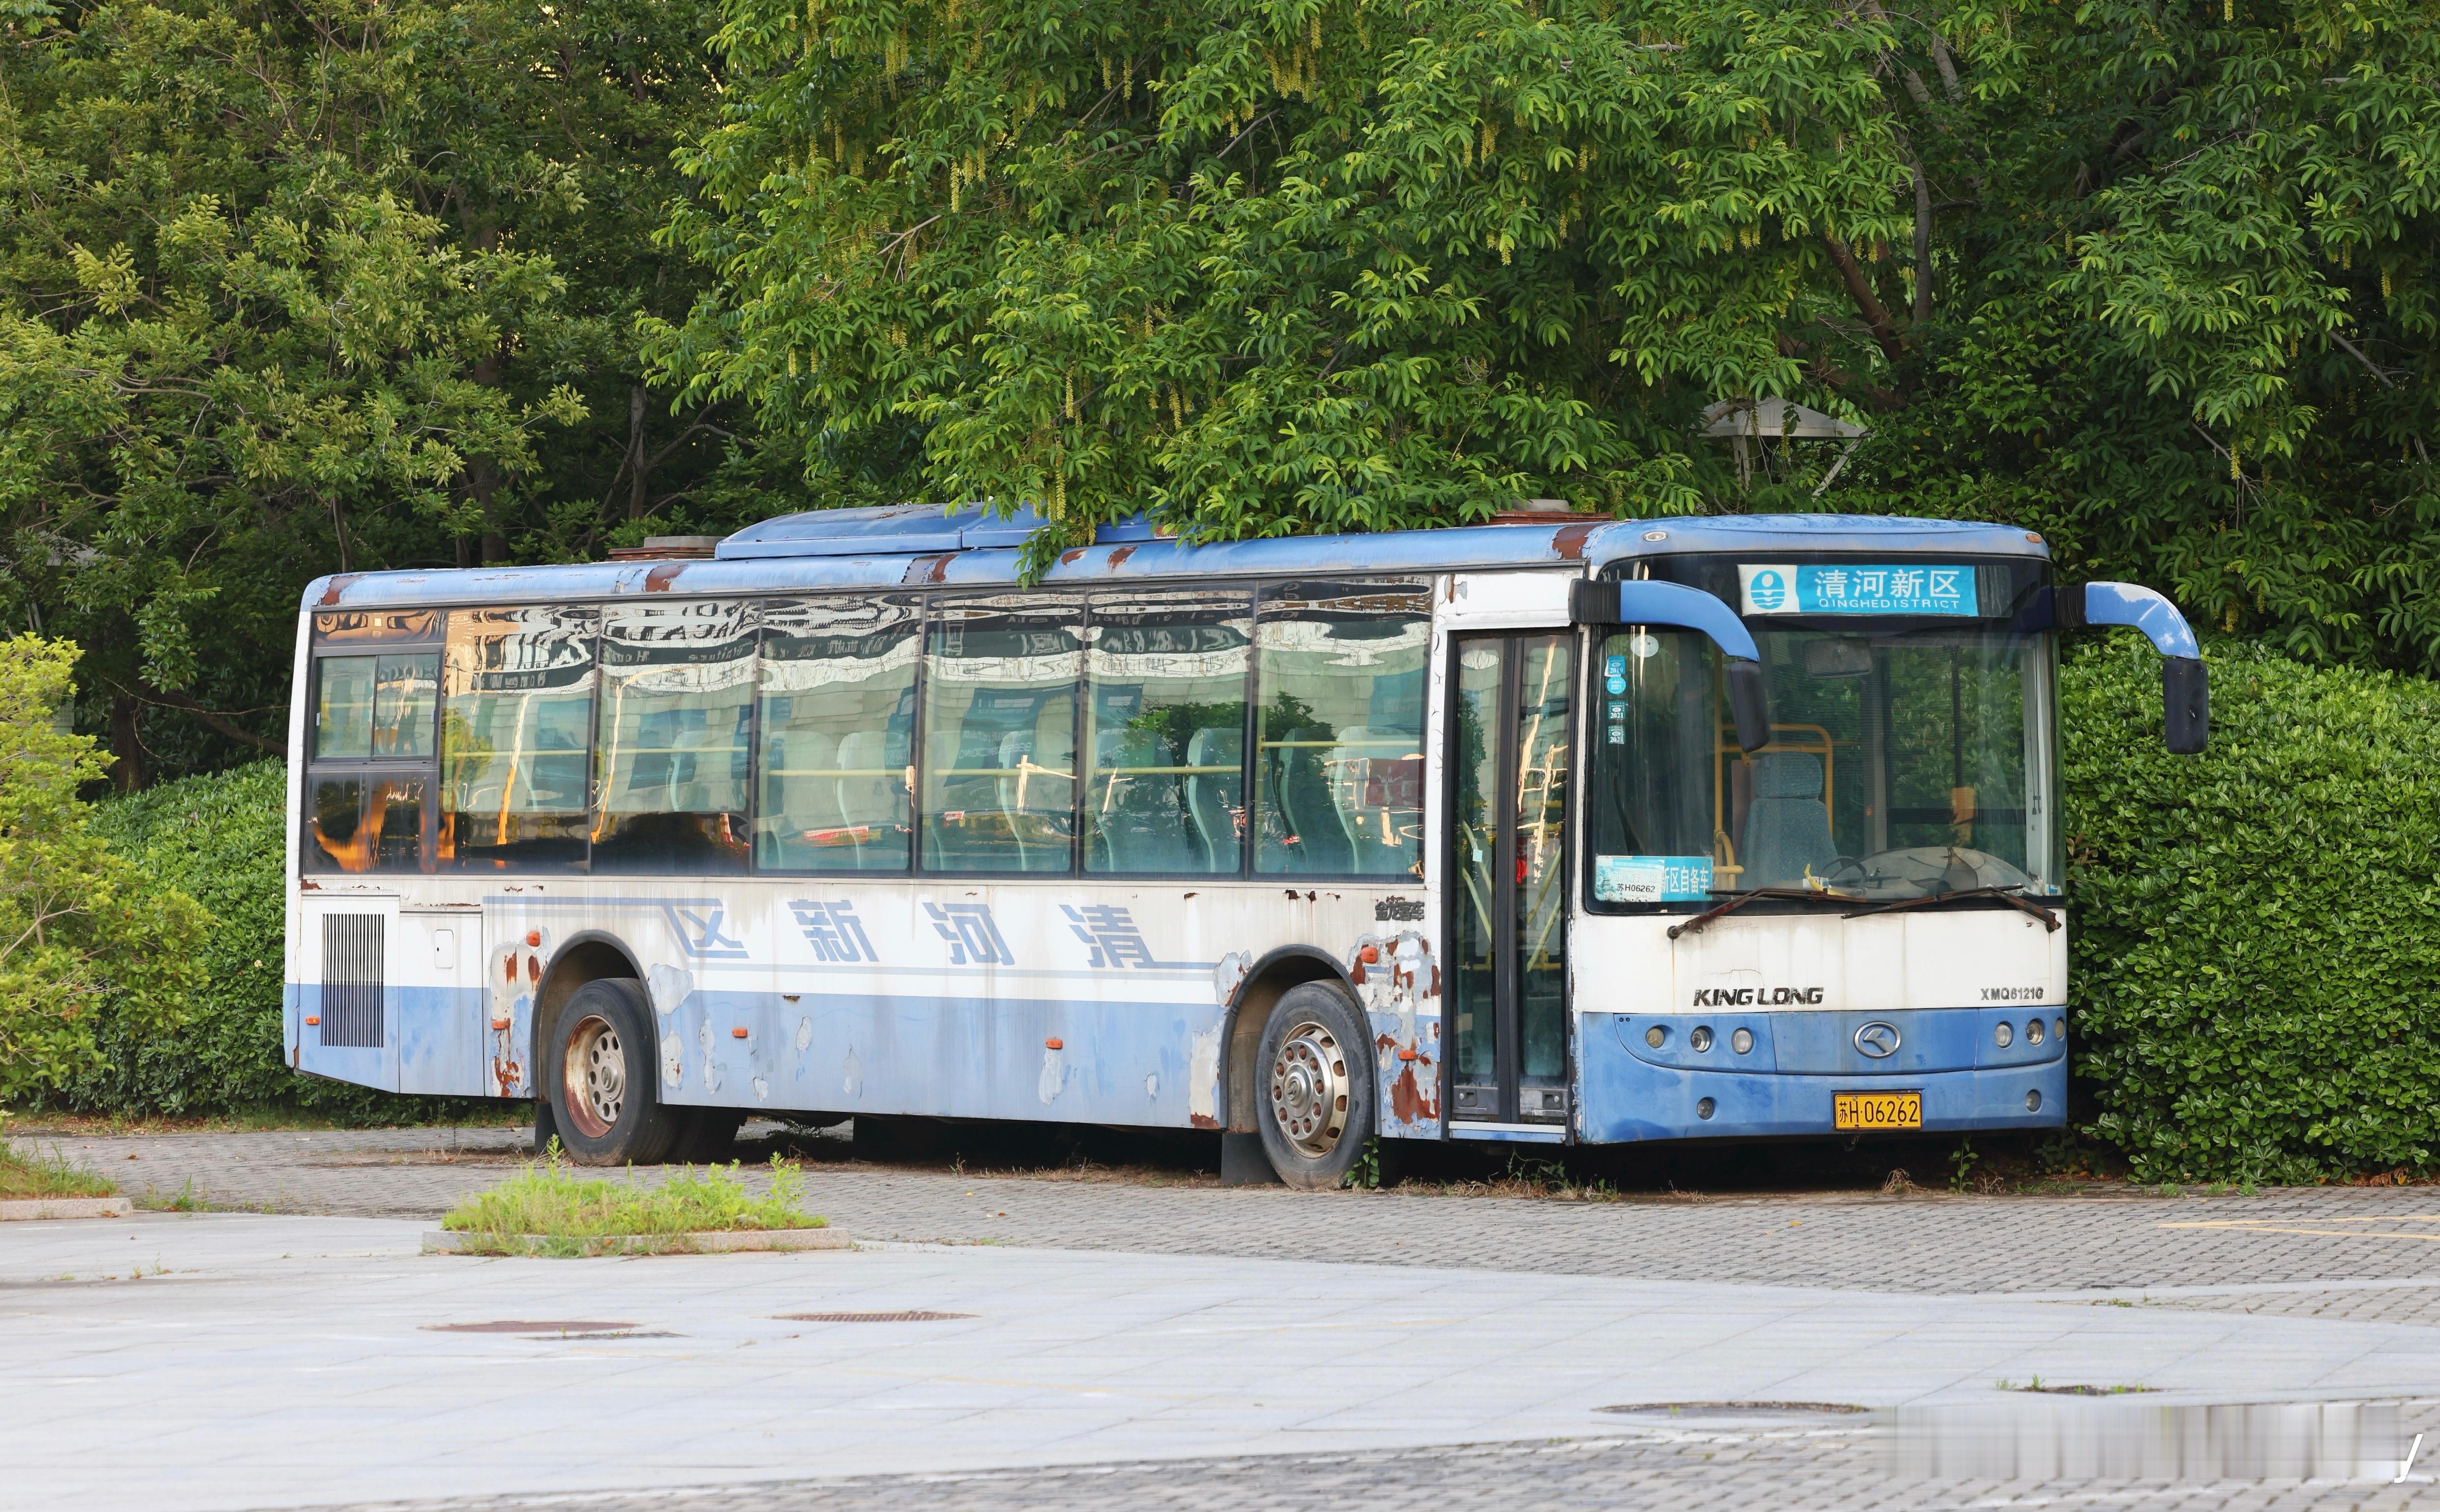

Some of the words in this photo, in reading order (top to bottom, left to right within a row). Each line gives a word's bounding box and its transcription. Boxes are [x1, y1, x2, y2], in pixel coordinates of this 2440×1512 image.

[1815, 569, 1960, 598] 清河新区
[1819, 598, 1959, 609] QINGHEDISTRICT
[1617, 883, 1655, 893] 苏H06262
[1375, 901, 1425, 921] 金龙客车
[1693, 989, 1754, 1006] KING
[1758, 987, 1824, 1005] LONG
[1980, 987, 2043, 1000] XMQ6121G
